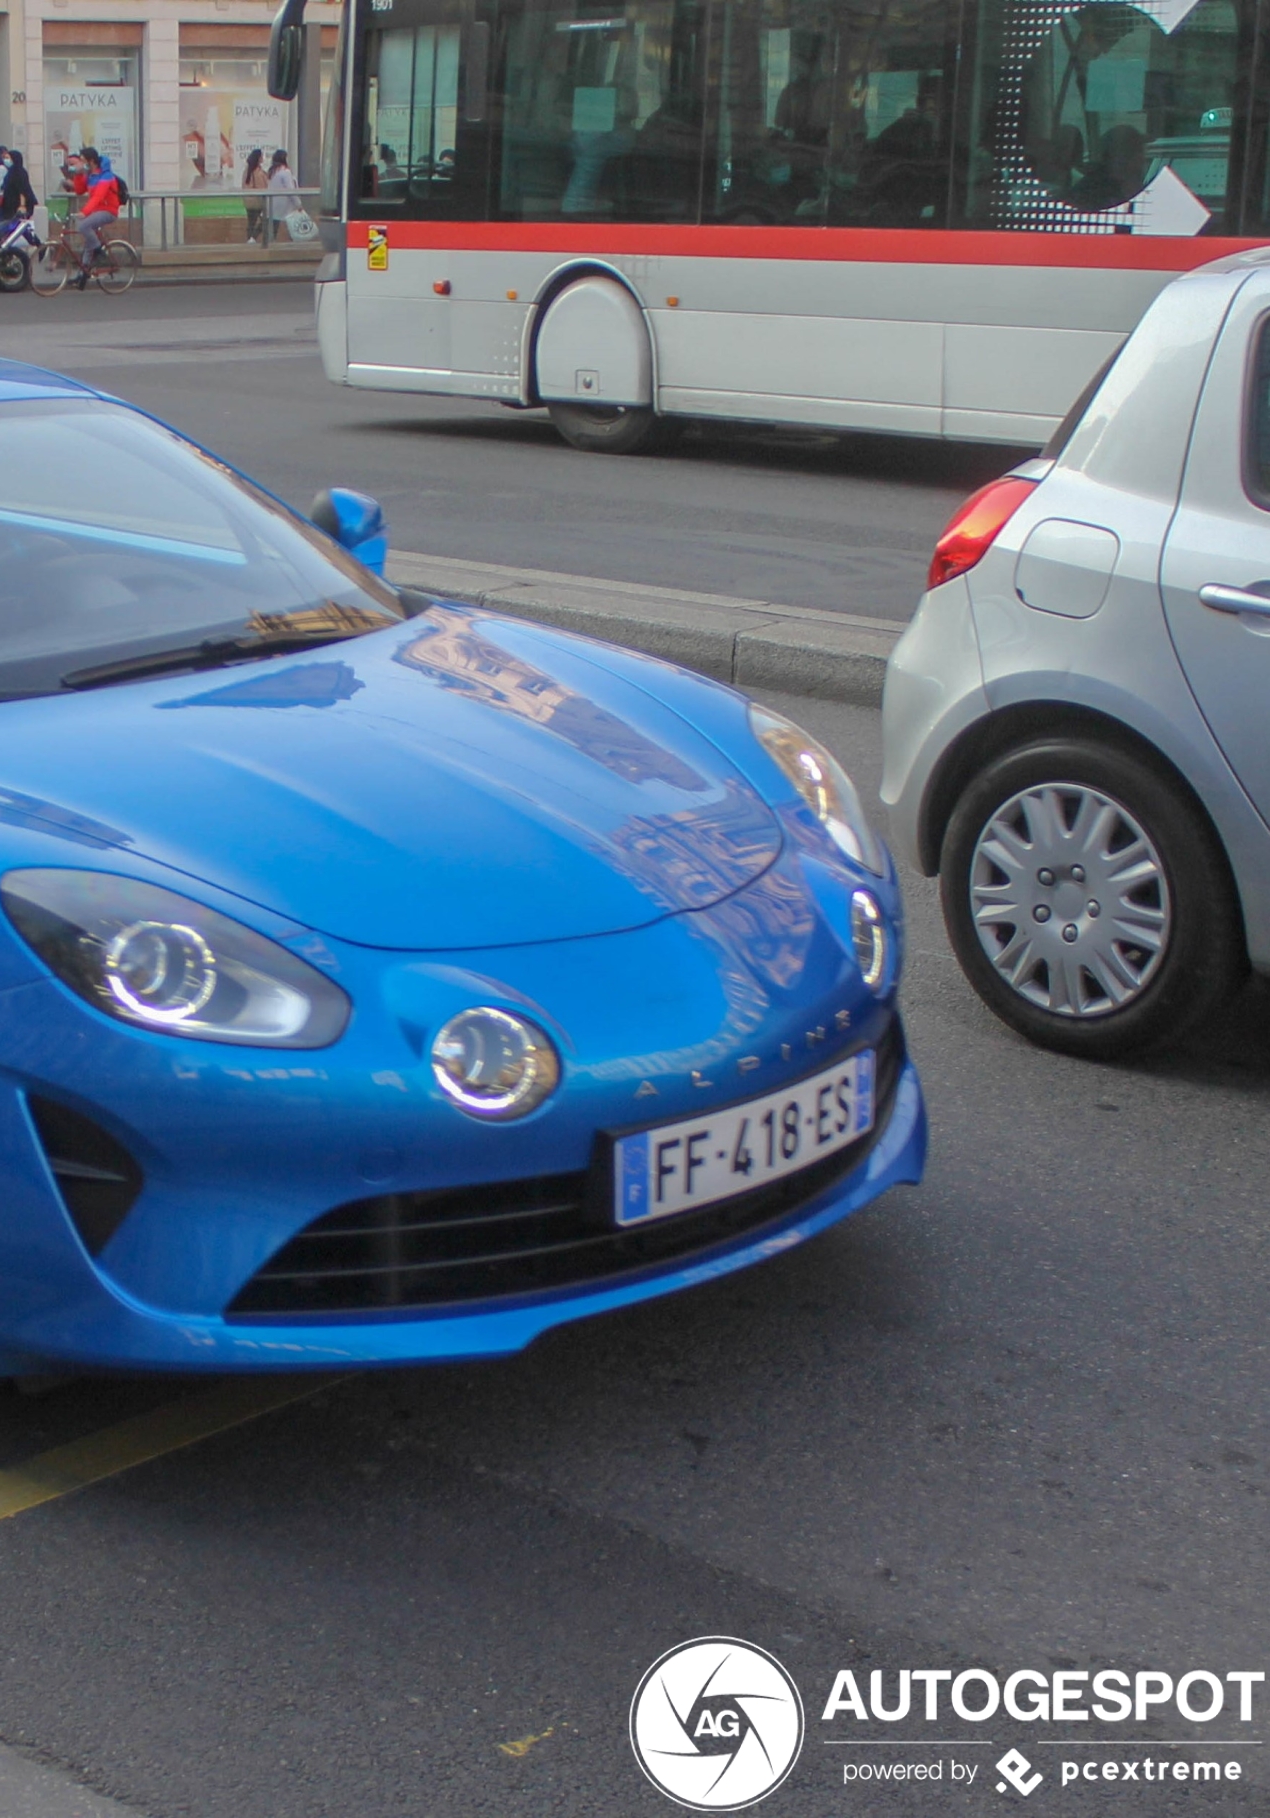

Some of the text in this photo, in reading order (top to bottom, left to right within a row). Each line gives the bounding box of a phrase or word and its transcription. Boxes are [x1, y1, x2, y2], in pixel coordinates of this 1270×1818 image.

[12, 91, 27, 104] 20
[60, 93, 117, 107] PATYKA
[235, 105, 279, 117] PATYKA
[633, 1008, 853, 1100] ALPINE
[652, 1074, 853, 1204] FF-418-ES
